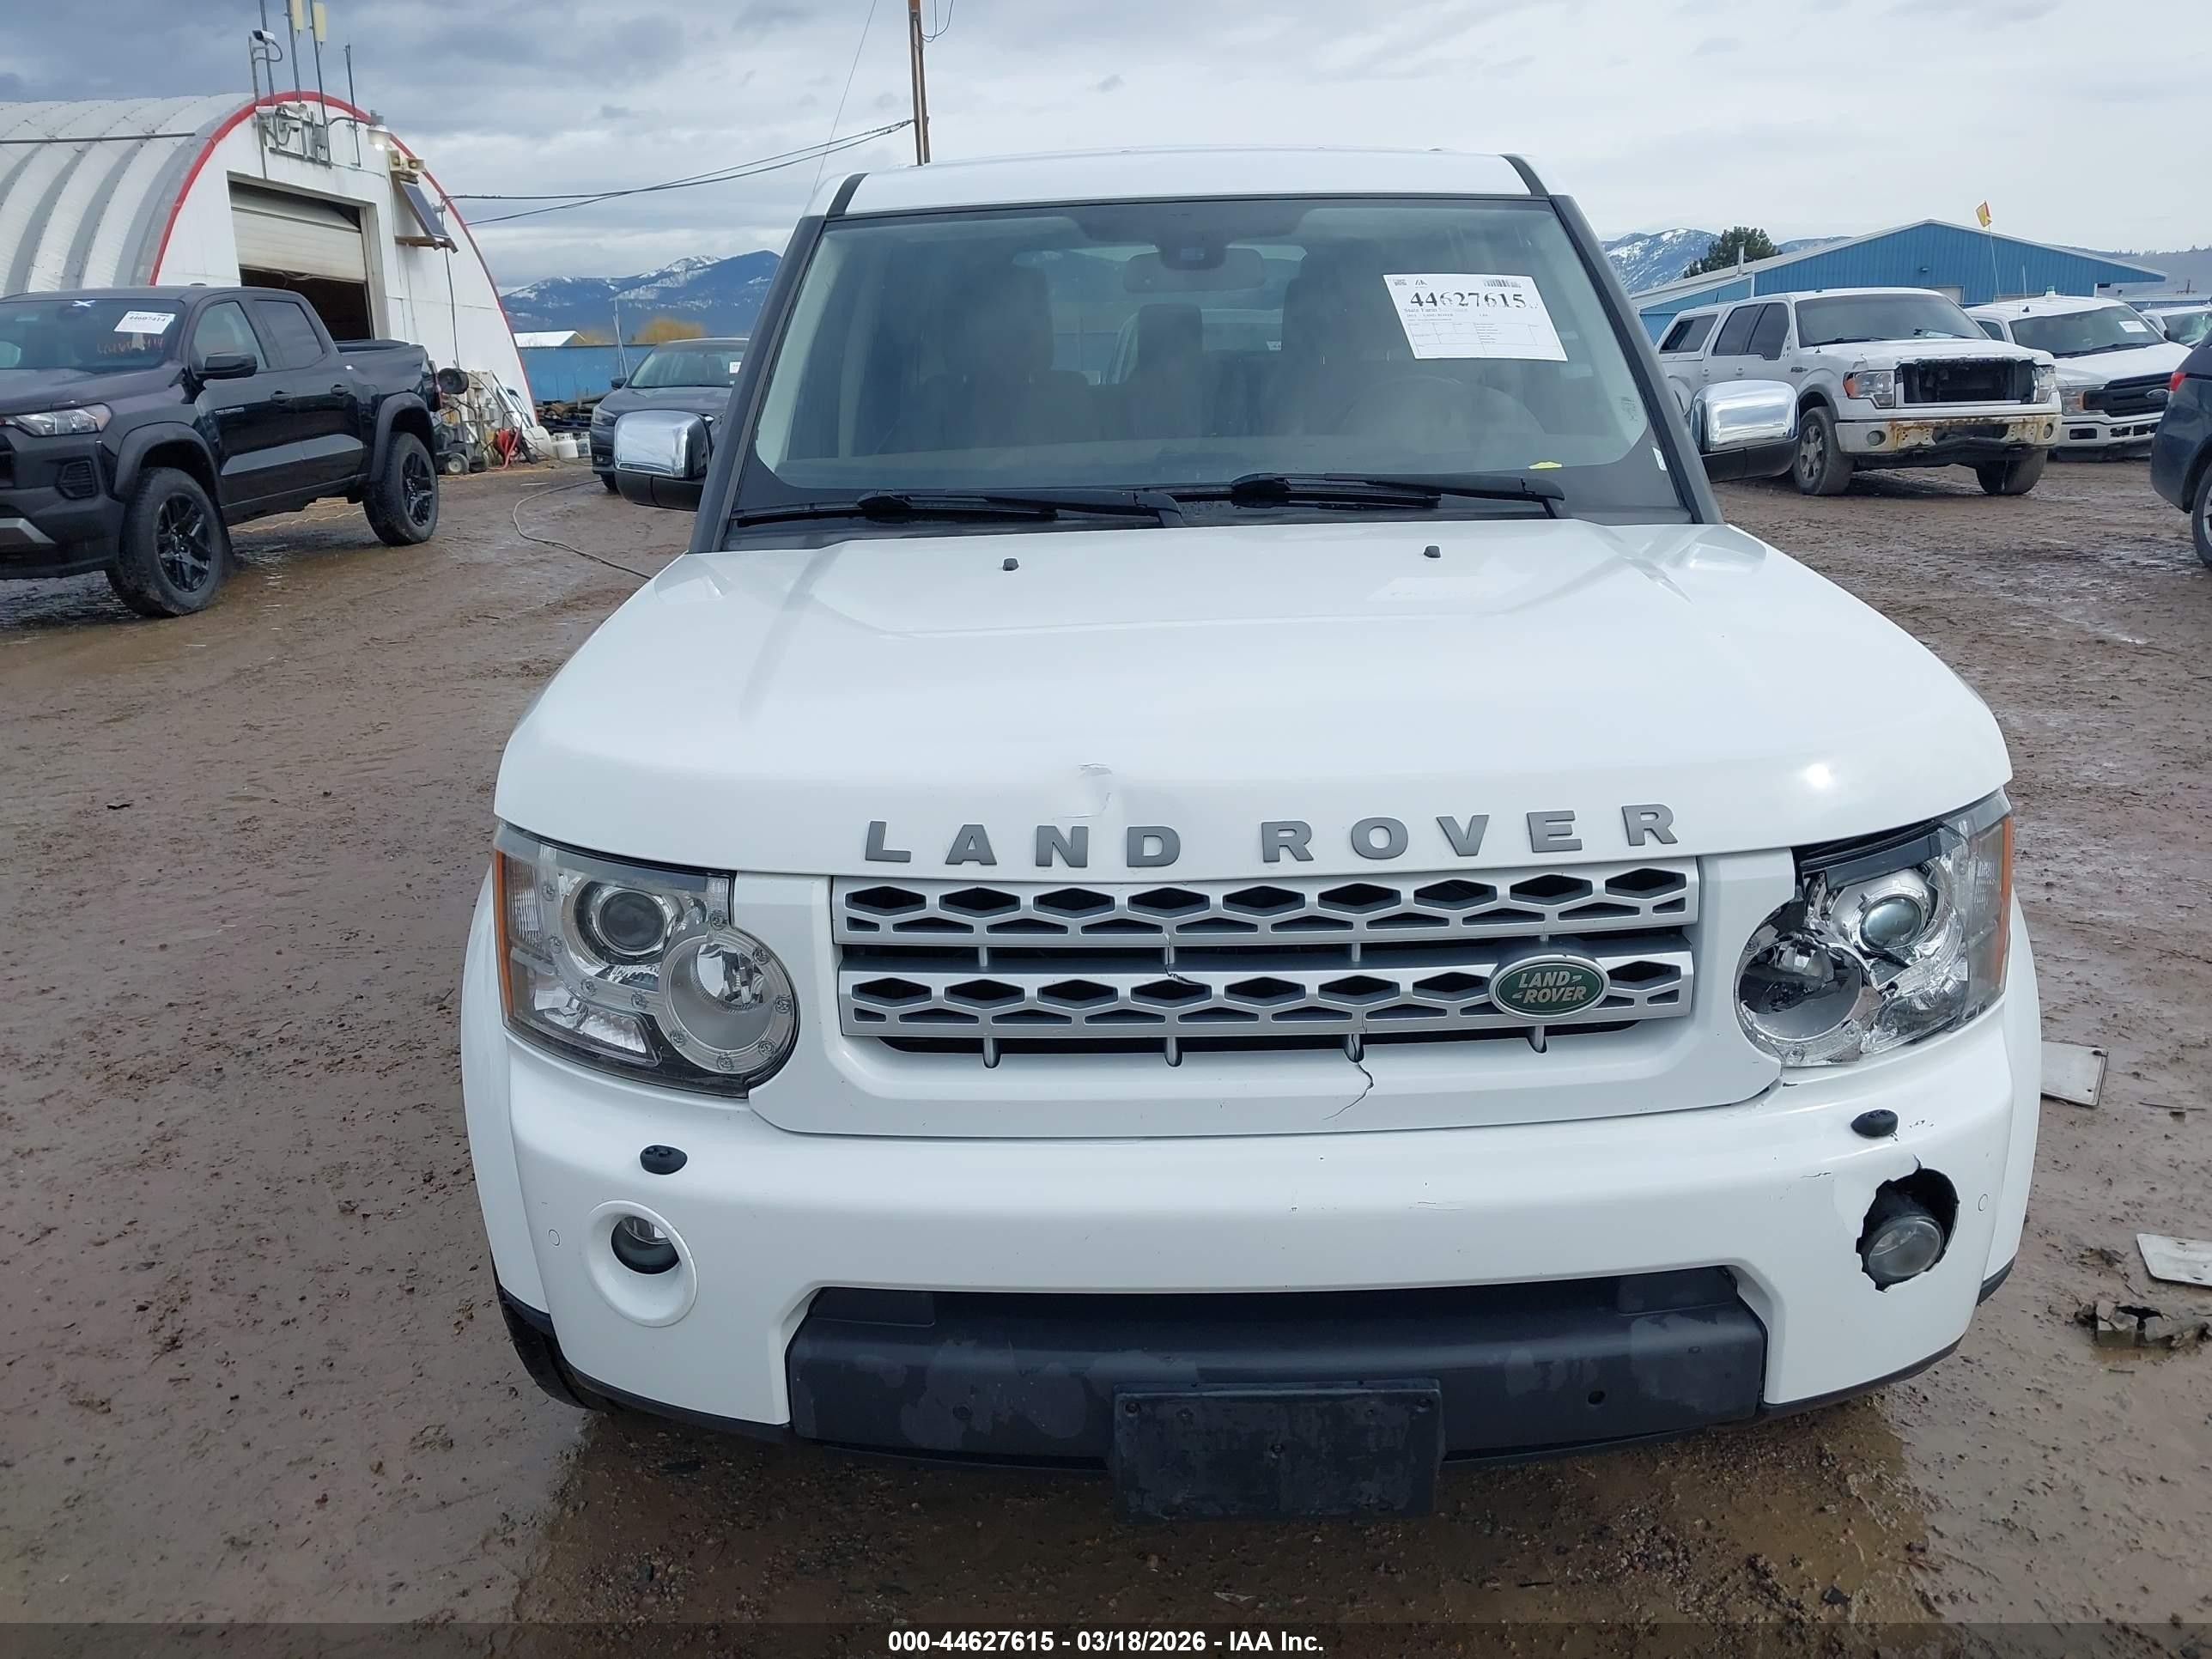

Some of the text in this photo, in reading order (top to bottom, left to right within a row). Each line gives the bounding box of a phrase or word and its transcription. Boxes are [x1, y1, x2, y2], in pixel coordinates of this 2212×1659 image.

[1410, 291, 1526, 308] 44627615
[865, 803, 1679, 867] LAND ROVER
[1518, 970, 1571, 988] LAND
[1523, 986, 1587, 1004] ROVER
